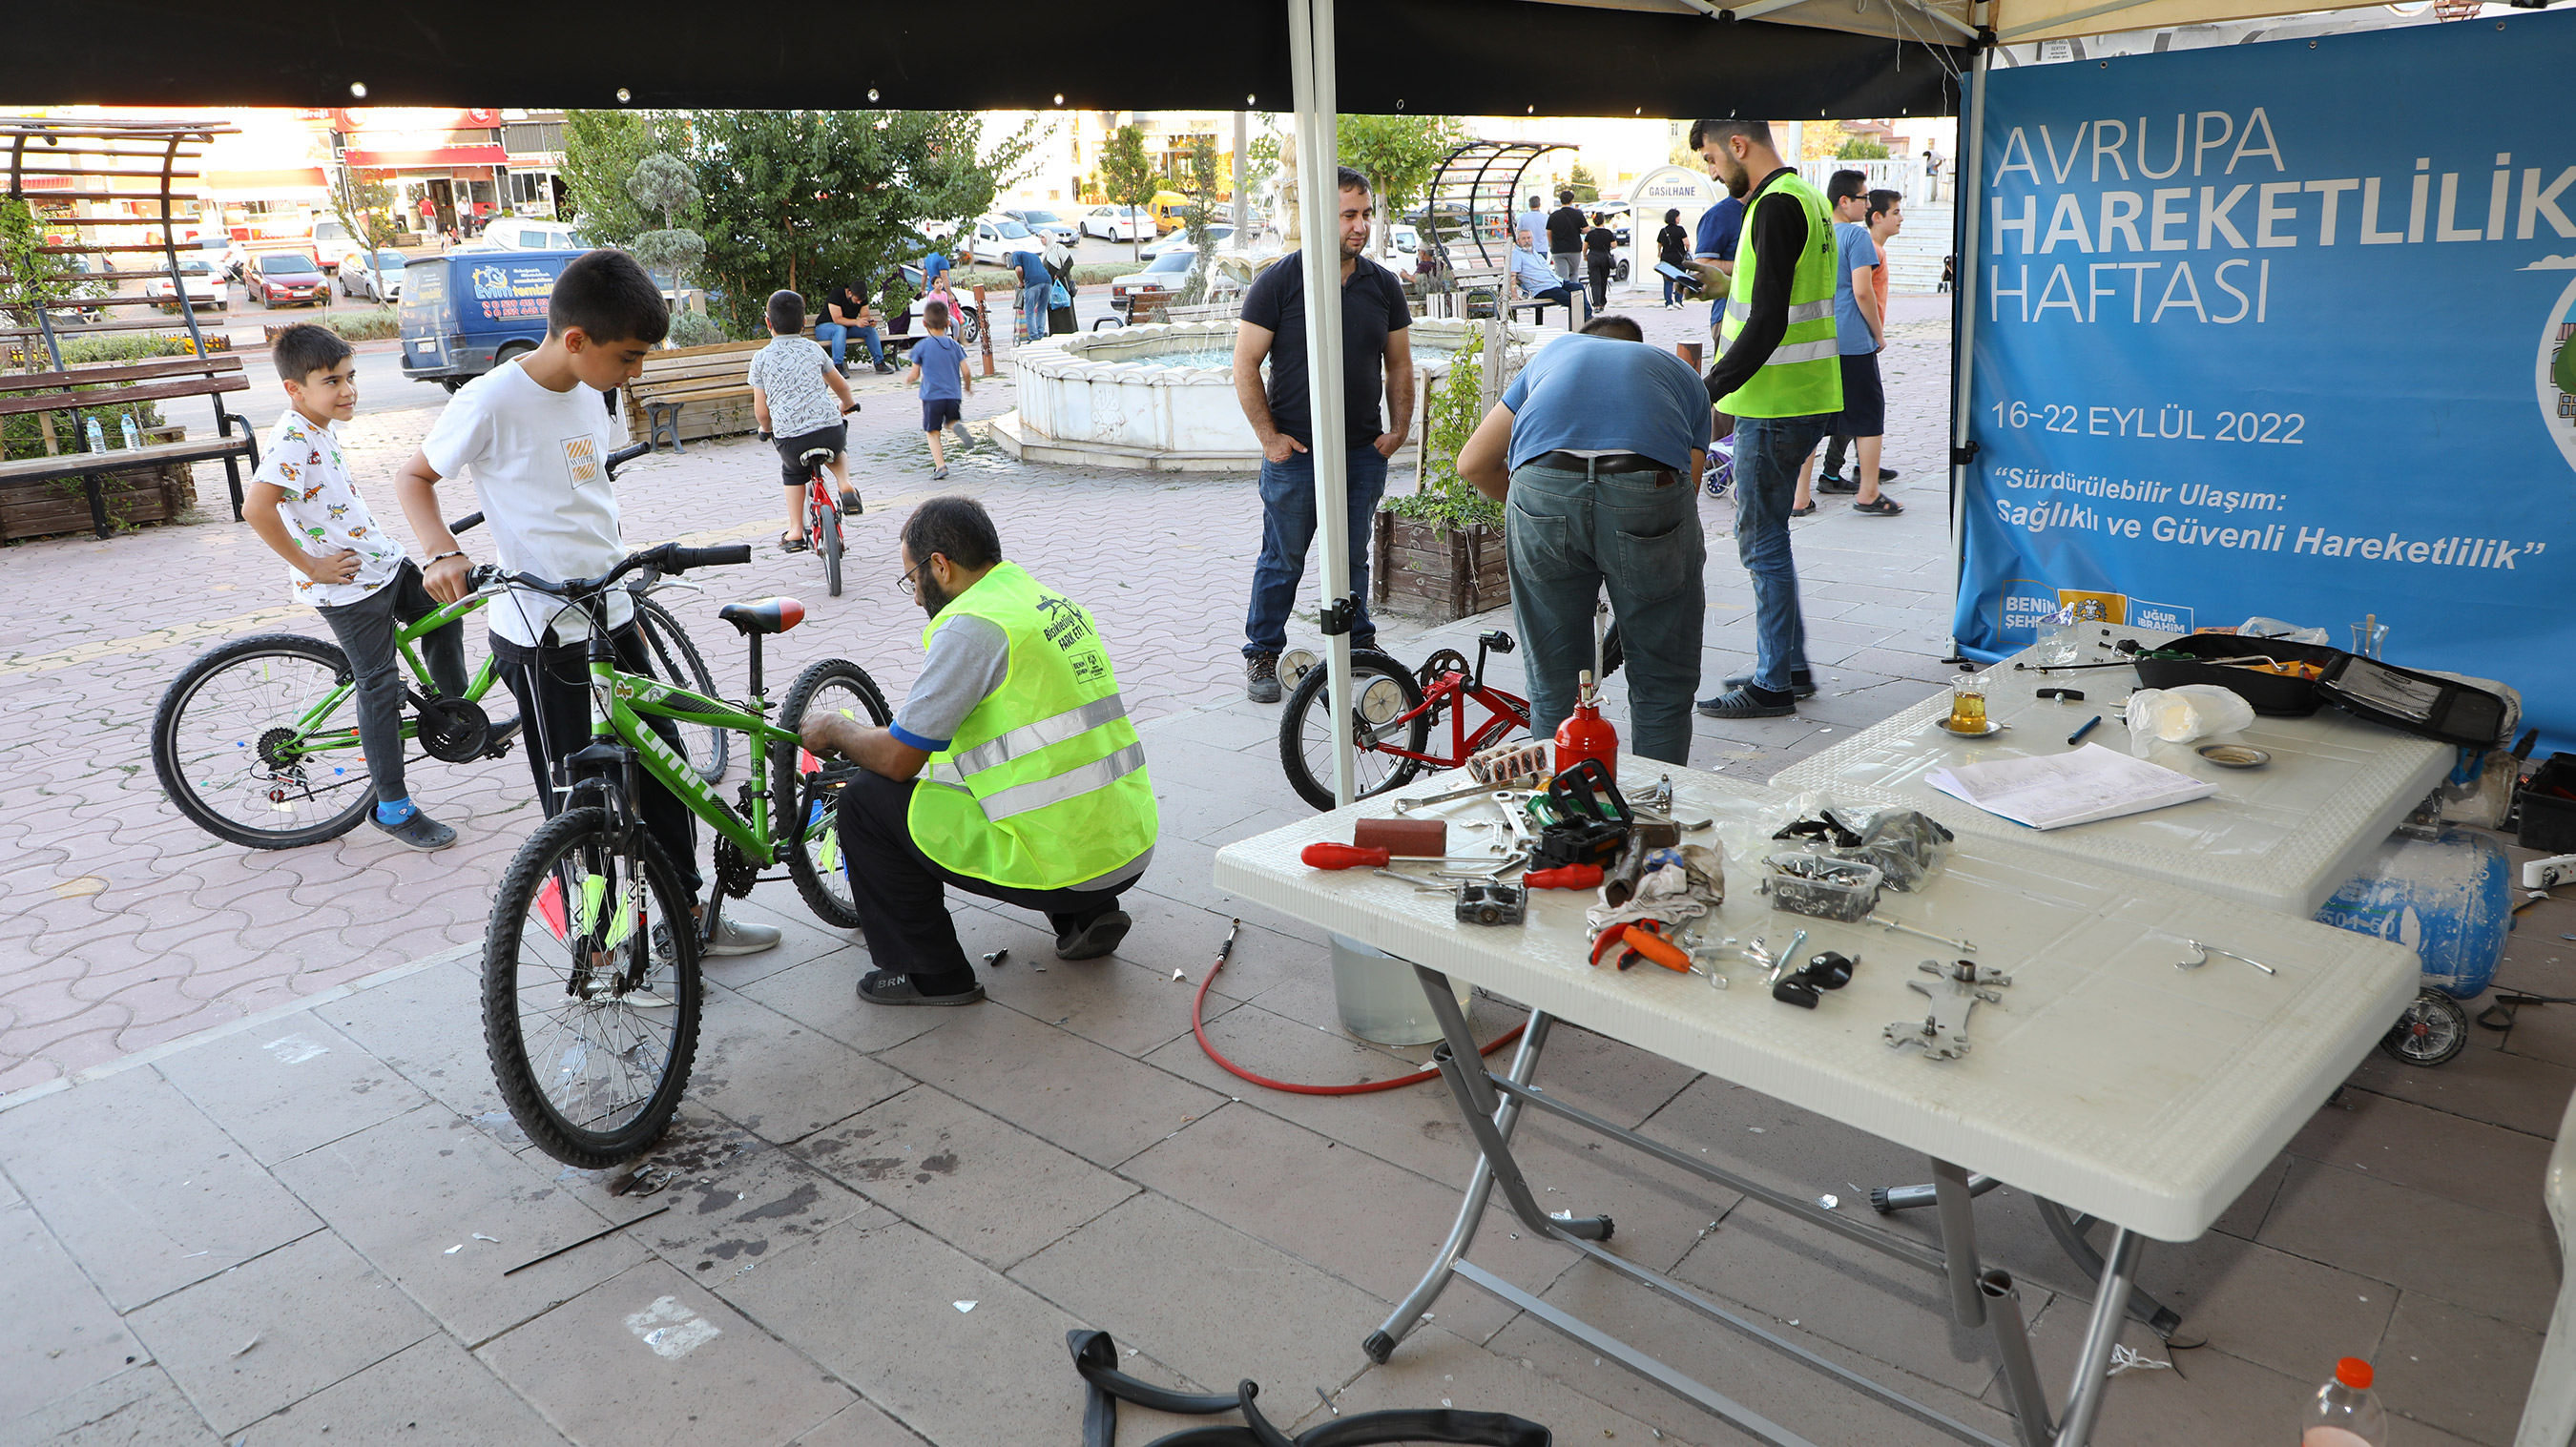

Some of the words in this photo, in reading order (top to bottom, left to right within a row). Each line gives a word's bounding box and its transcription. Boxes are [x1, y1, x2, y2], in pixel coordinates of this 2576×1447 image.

[1992, 107, 2285, 187] AVRUPA
[1991, 152, 2576, 255] HAREKETLİLİK
[512, 282, 556, 298] temizli
[1990, 258, 2270, 324] HAFTASI
[2088, 403, 2206, 440] EYLÜL
[2215, 411, 2305, 444] 2022
[2179, 483, 2287, 513] Ulaşım:
[1996, 499, 2099, 533] Sağlıklı
[2107, 516, 2141, 539] ve
[2151, 515, 2286, 552] Güvenli
[2142, 609, 2176, 624] UĞUR
[877, 973, 906, 989] BRN
